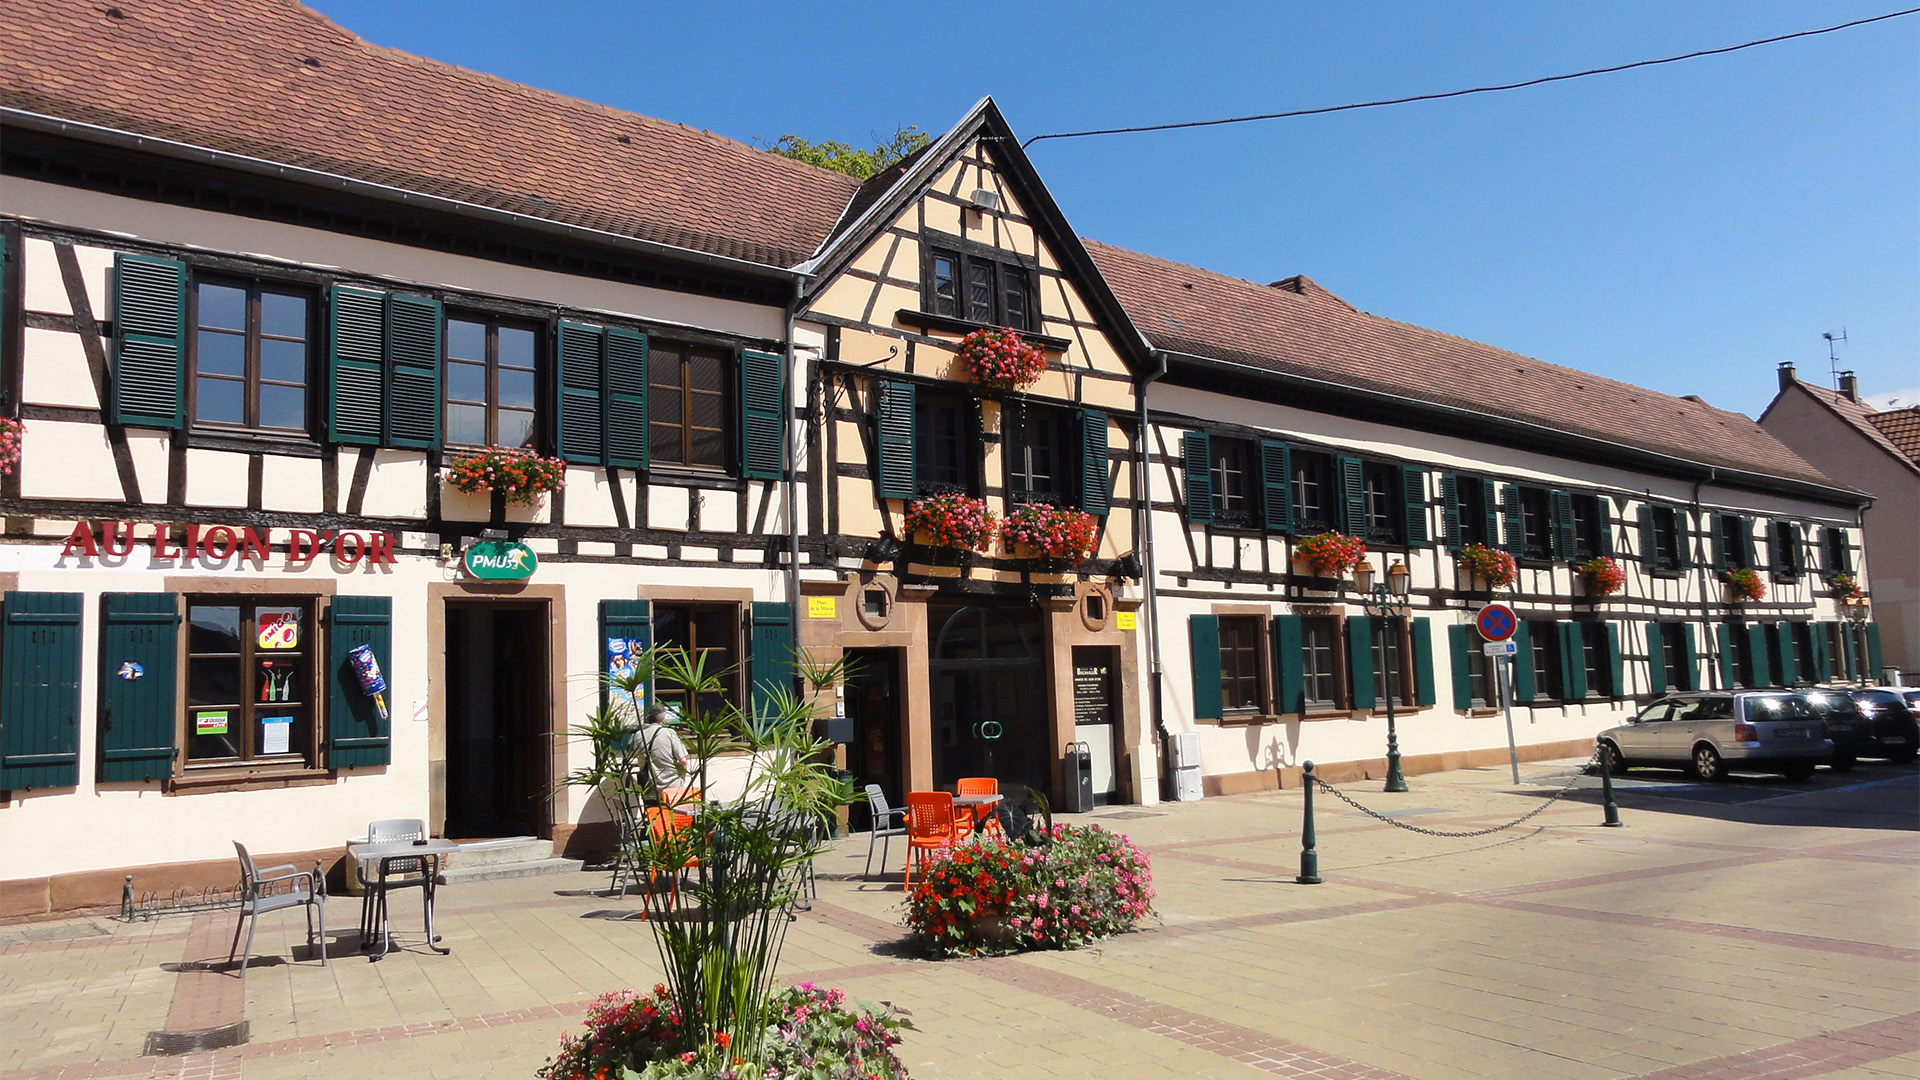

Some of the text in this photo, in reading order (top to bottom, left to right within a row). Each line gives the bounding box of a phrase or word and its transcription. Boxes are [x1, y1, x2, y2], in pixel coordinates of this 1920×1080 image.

[60, 520, 399, 564] AU LION D'OR
[472, 554, 508, 568] PMU
